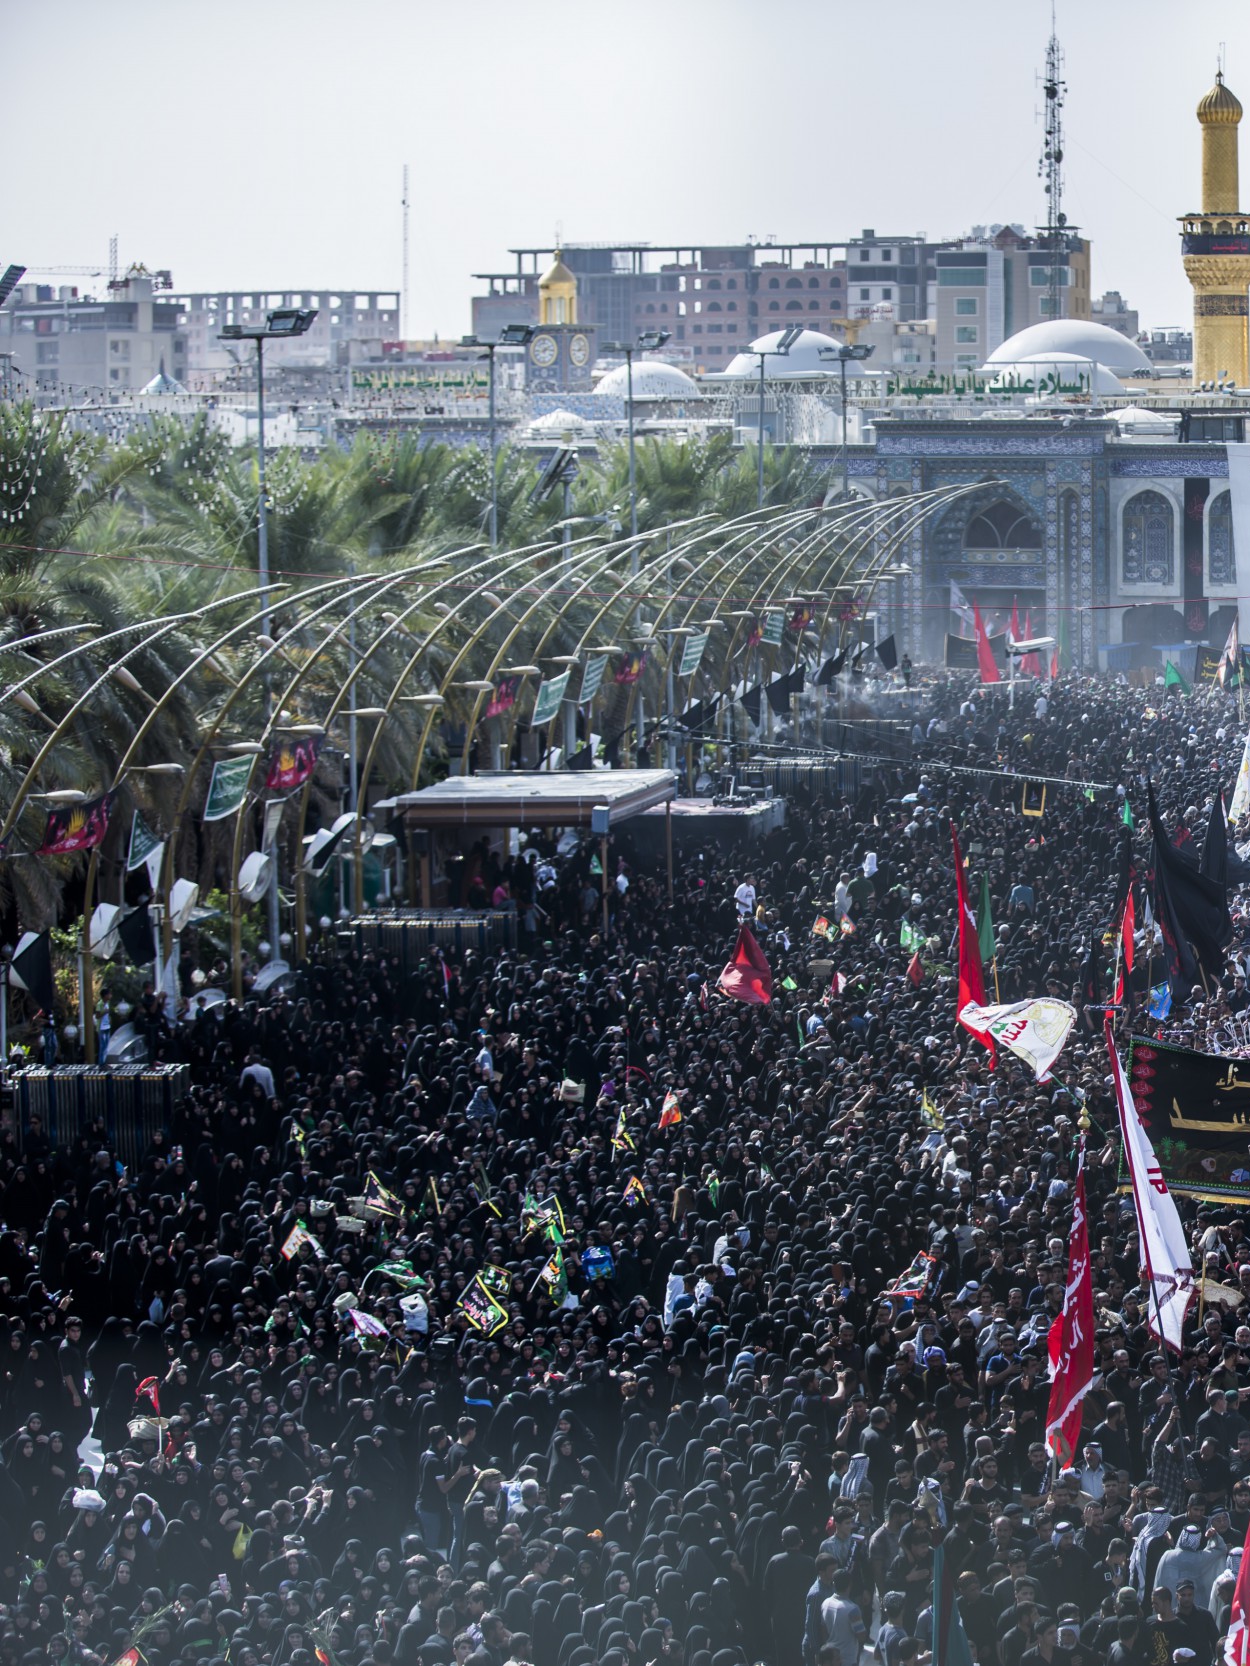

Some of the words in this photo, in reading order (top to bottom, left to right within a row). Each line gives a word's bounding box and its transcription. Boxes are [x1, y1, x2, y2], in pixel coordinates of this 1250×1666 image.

[886, 368, 950, 401] الشهداء
[989, 372, 1036, 401] عليك
[1038, 371, 1090, 400] السلام
